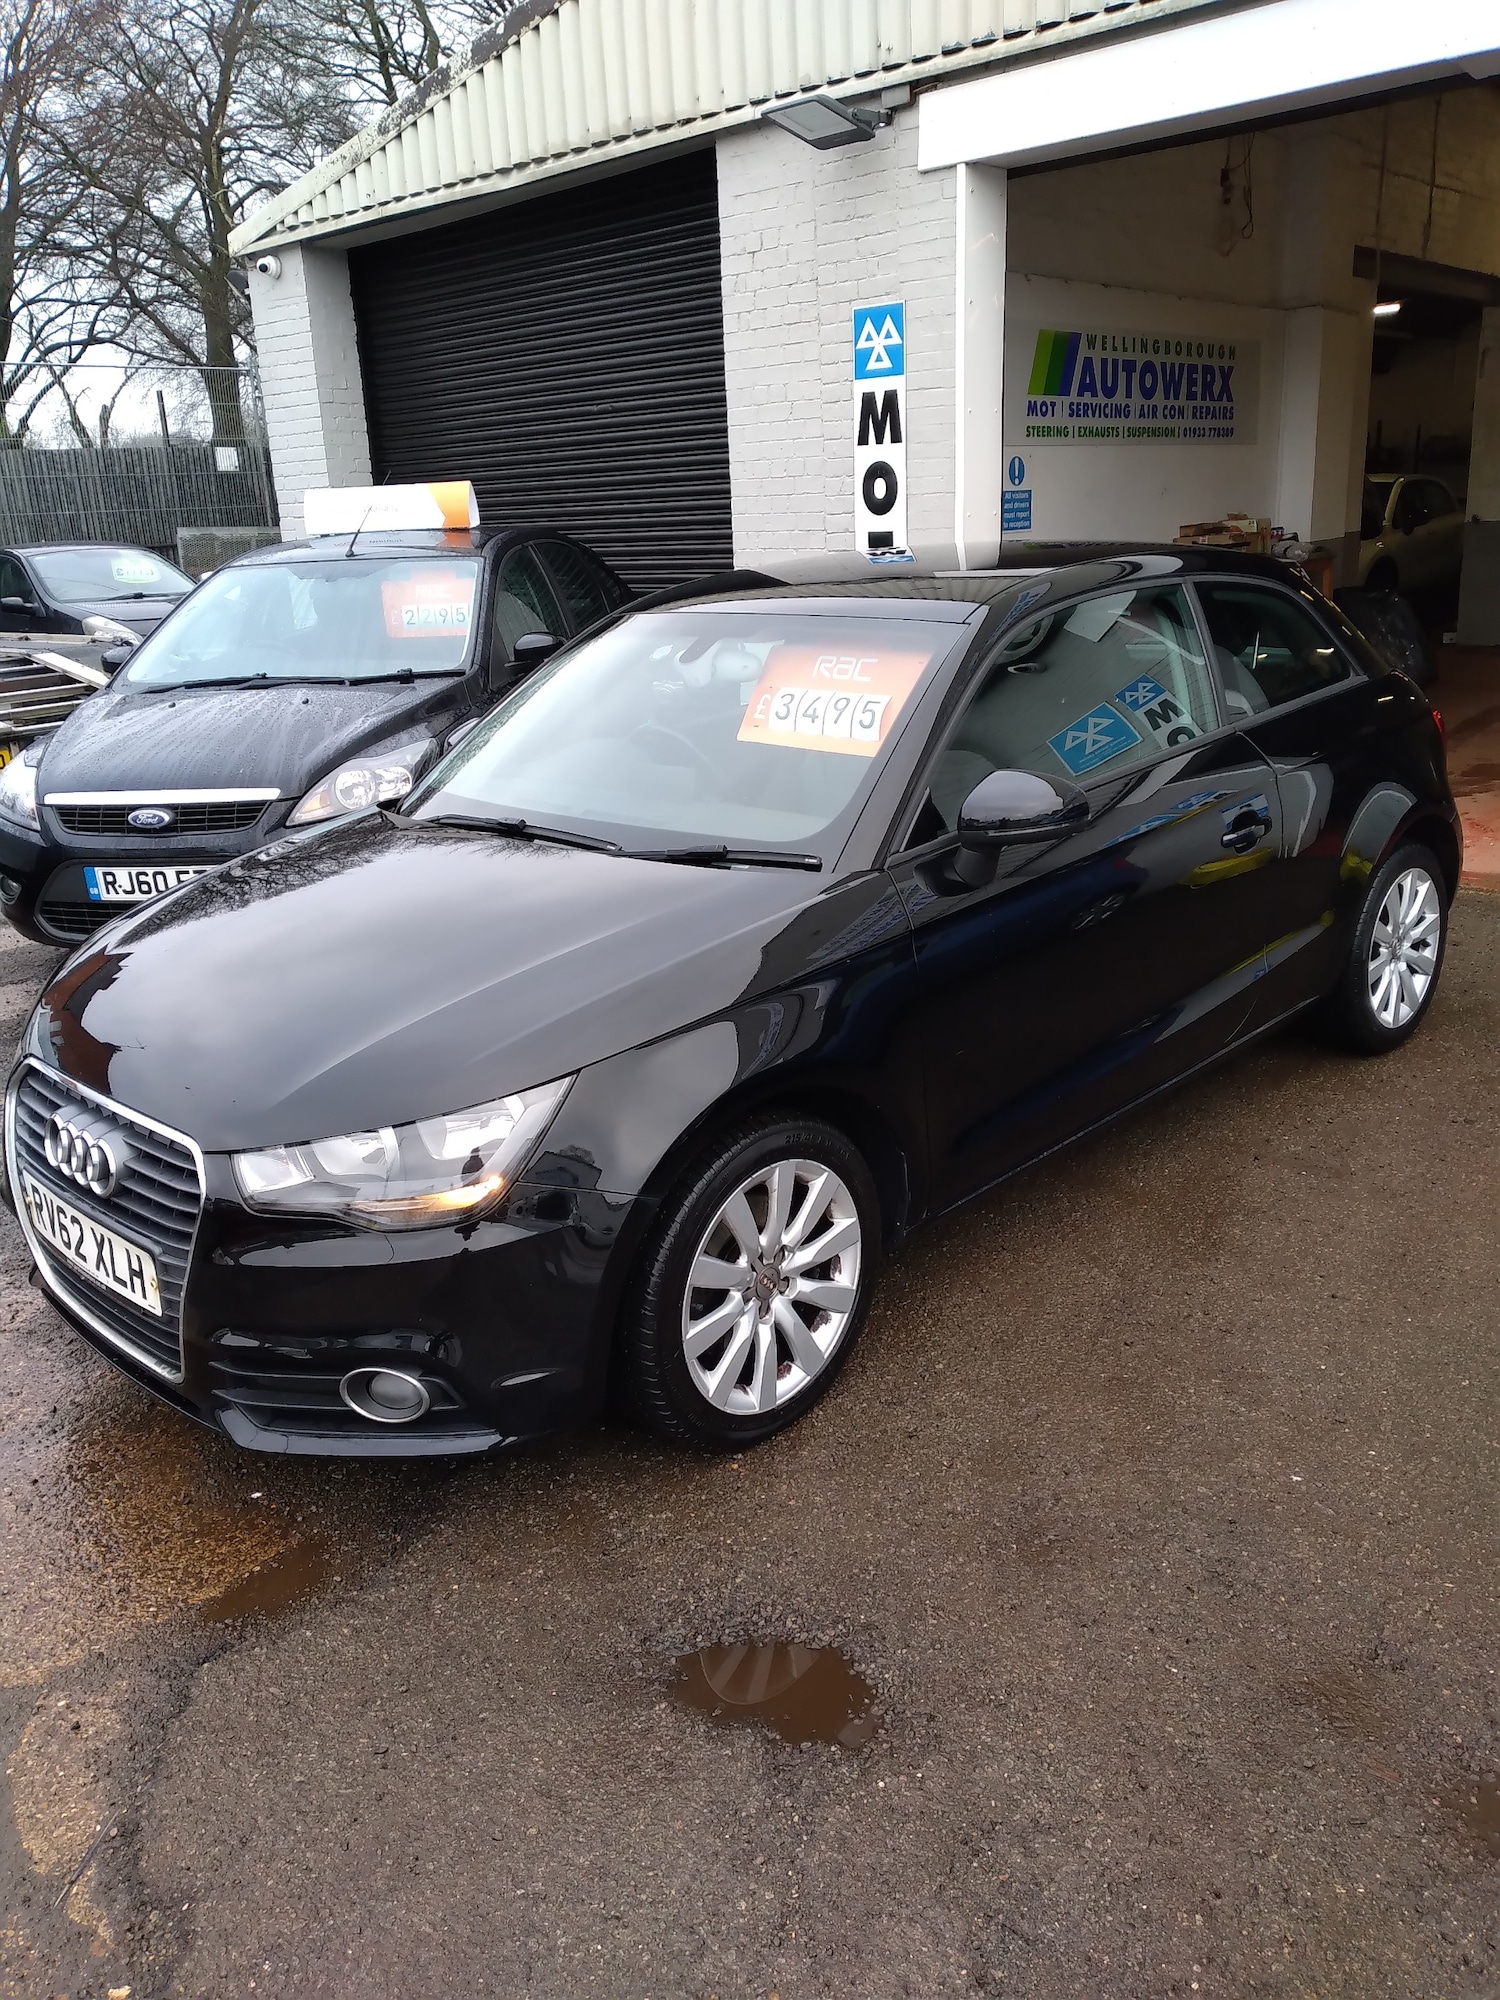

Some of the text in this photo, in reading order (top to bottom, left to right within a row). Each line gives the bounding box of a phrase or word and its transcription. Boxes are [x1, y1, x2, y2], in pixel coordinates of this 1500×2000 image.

[1086, 334, 1236, 360] WELLINGBOROUGH
[1076, 356, 1234, 402] AUTOWERX
[1026, 400, 1057, 417] MOT
[1068, 402, 1131, 419] SERVICING
[1139, 403, 1185, 420] AIR CON
[1191, 405, 1234, 420] REPAIRS
[1025, 425, 1069, 438] STEERING
[1077, 425, 1120, 438] EXHAUSTS
[1126, 425, 1176, 438] SUSPENSION
[1183, 426, 1206, 438] 01933
[1016, 511, 1029, 519] report
[1009, 520, 1030, 528] reception
[136, 813, 159, 824] Ford
[101, 870, 169, 895] RJ60
[30, 1183, 88, 1264] RV62
[90, 1226, 148, 1301] XLH
